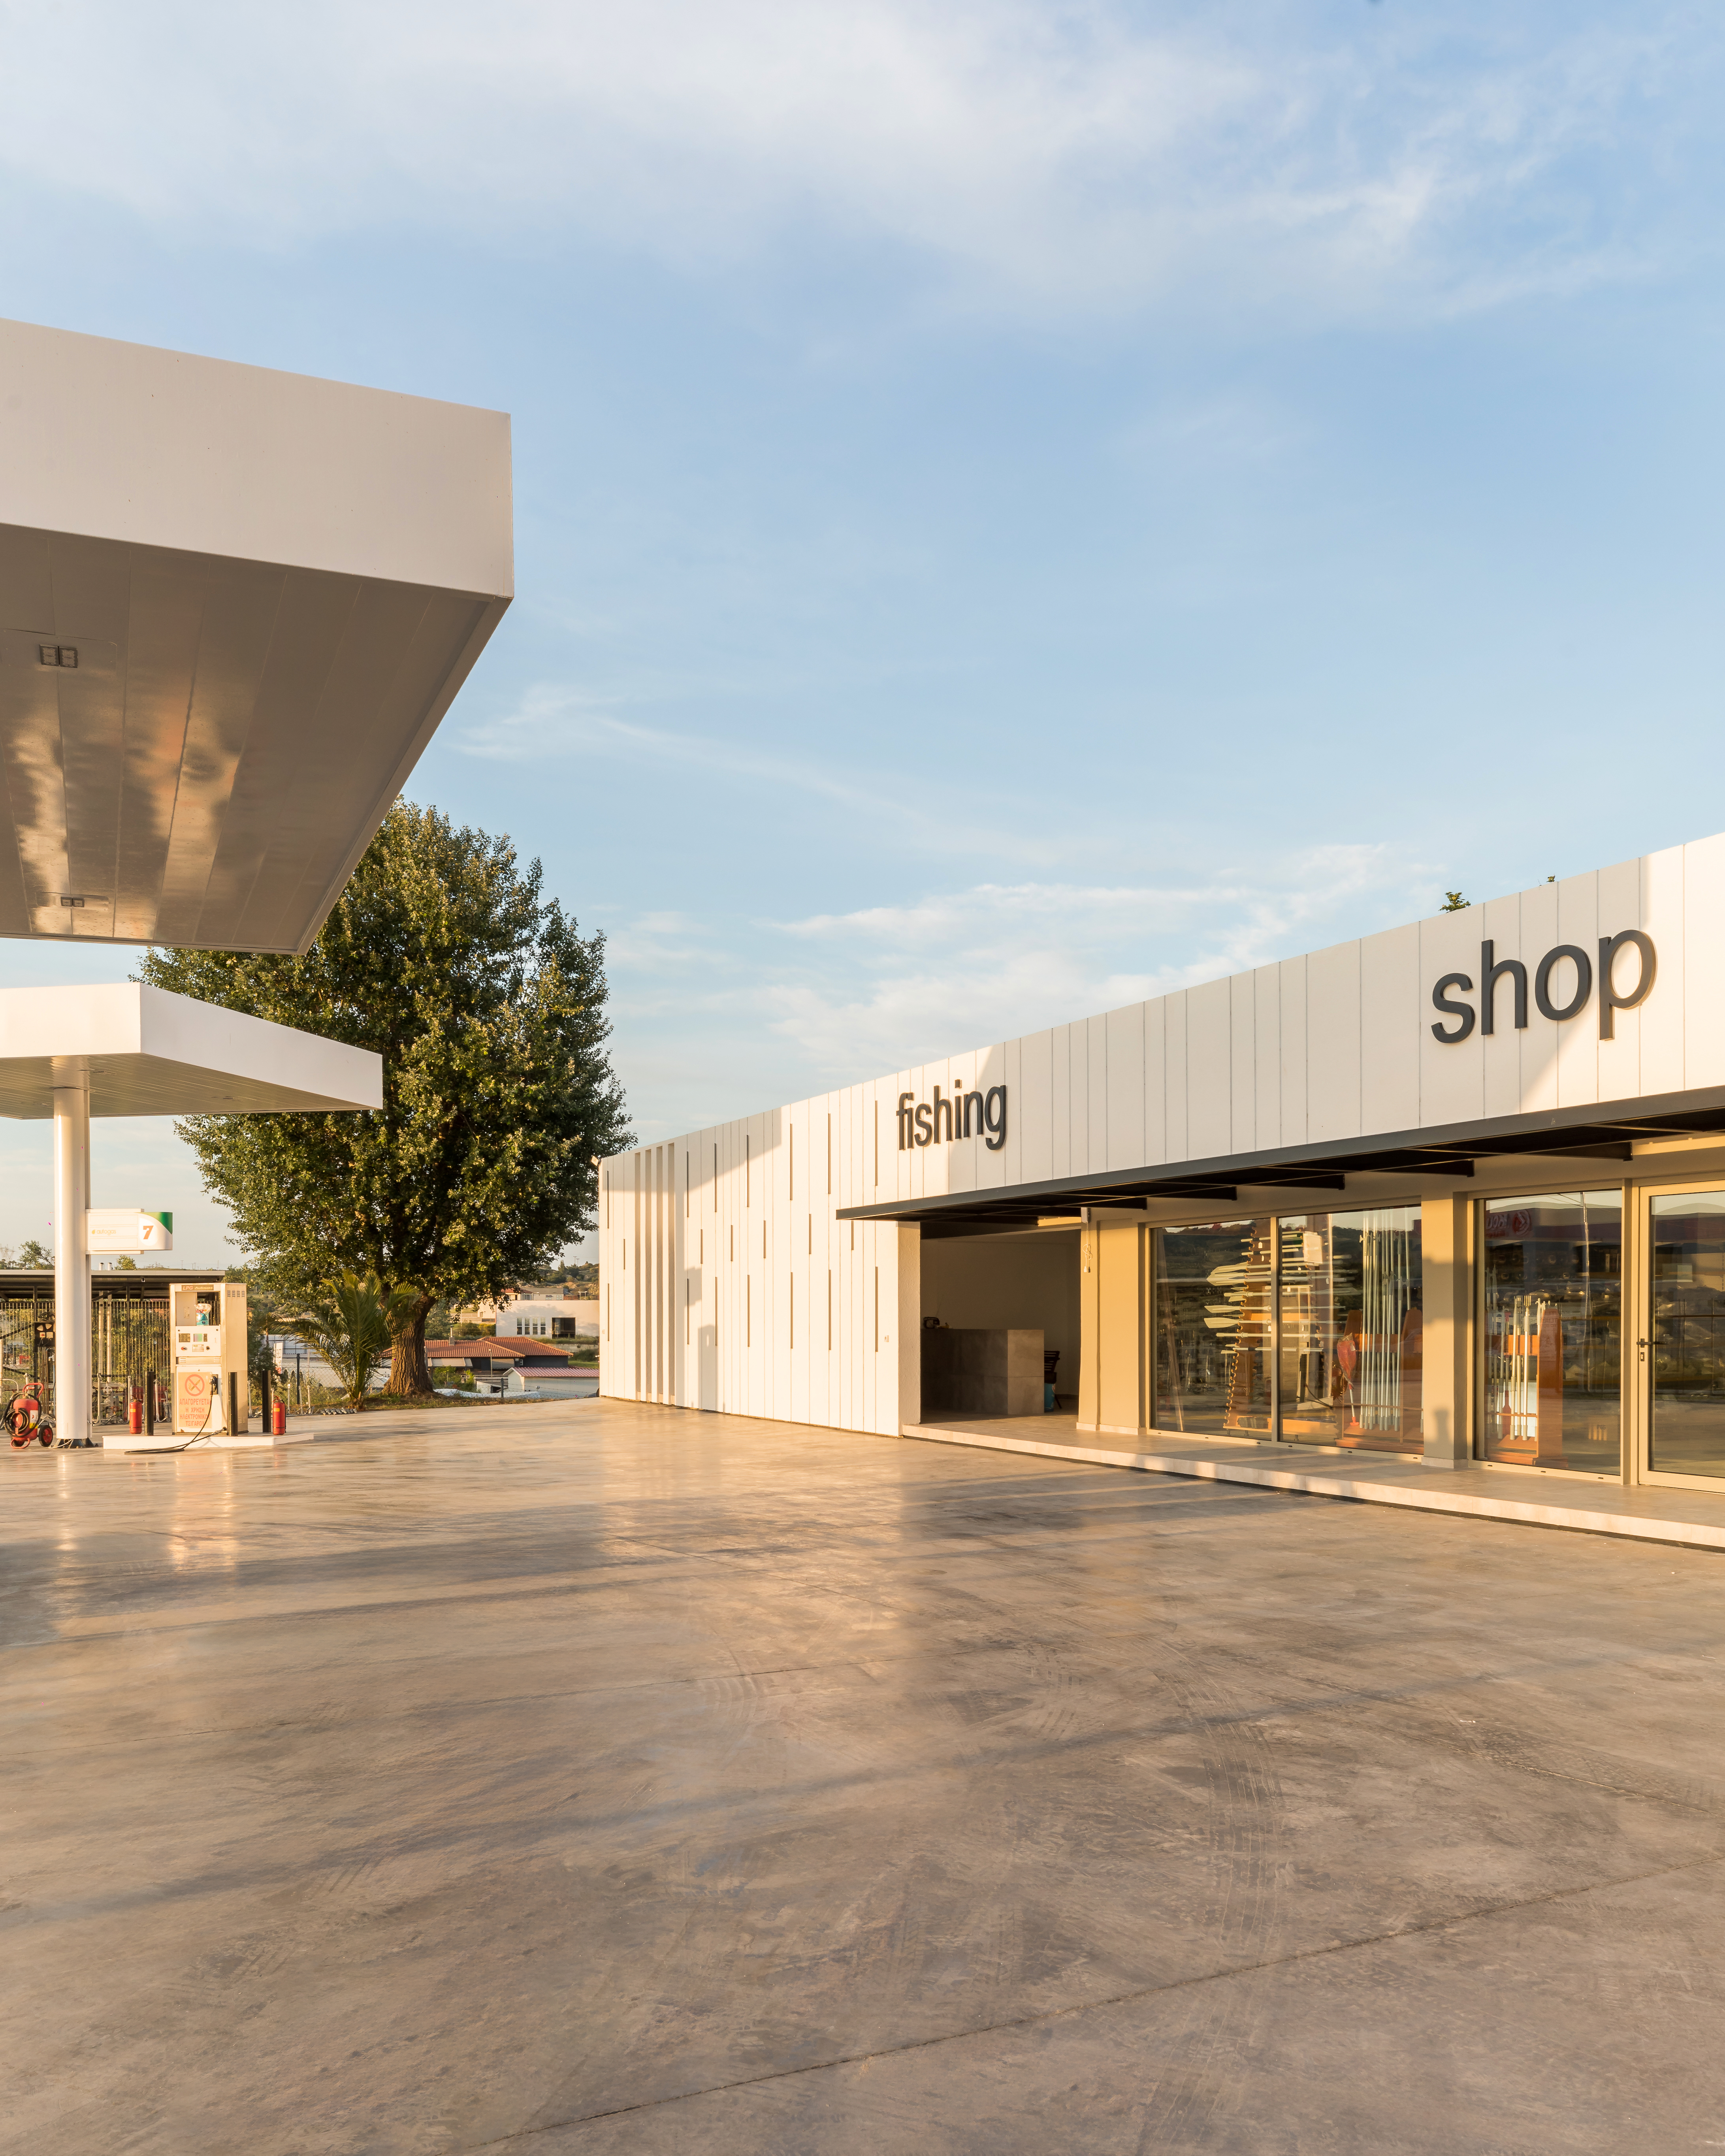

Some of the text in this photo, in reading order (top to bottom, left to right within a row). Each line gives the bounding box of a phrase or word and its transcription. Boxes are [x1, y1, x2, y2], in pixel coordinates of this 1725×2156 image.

[1431, 929, 1657, 1043] shop
[896, 1079, 1007, 1150] fishing
[143, 1225, 154, 1239] 7
